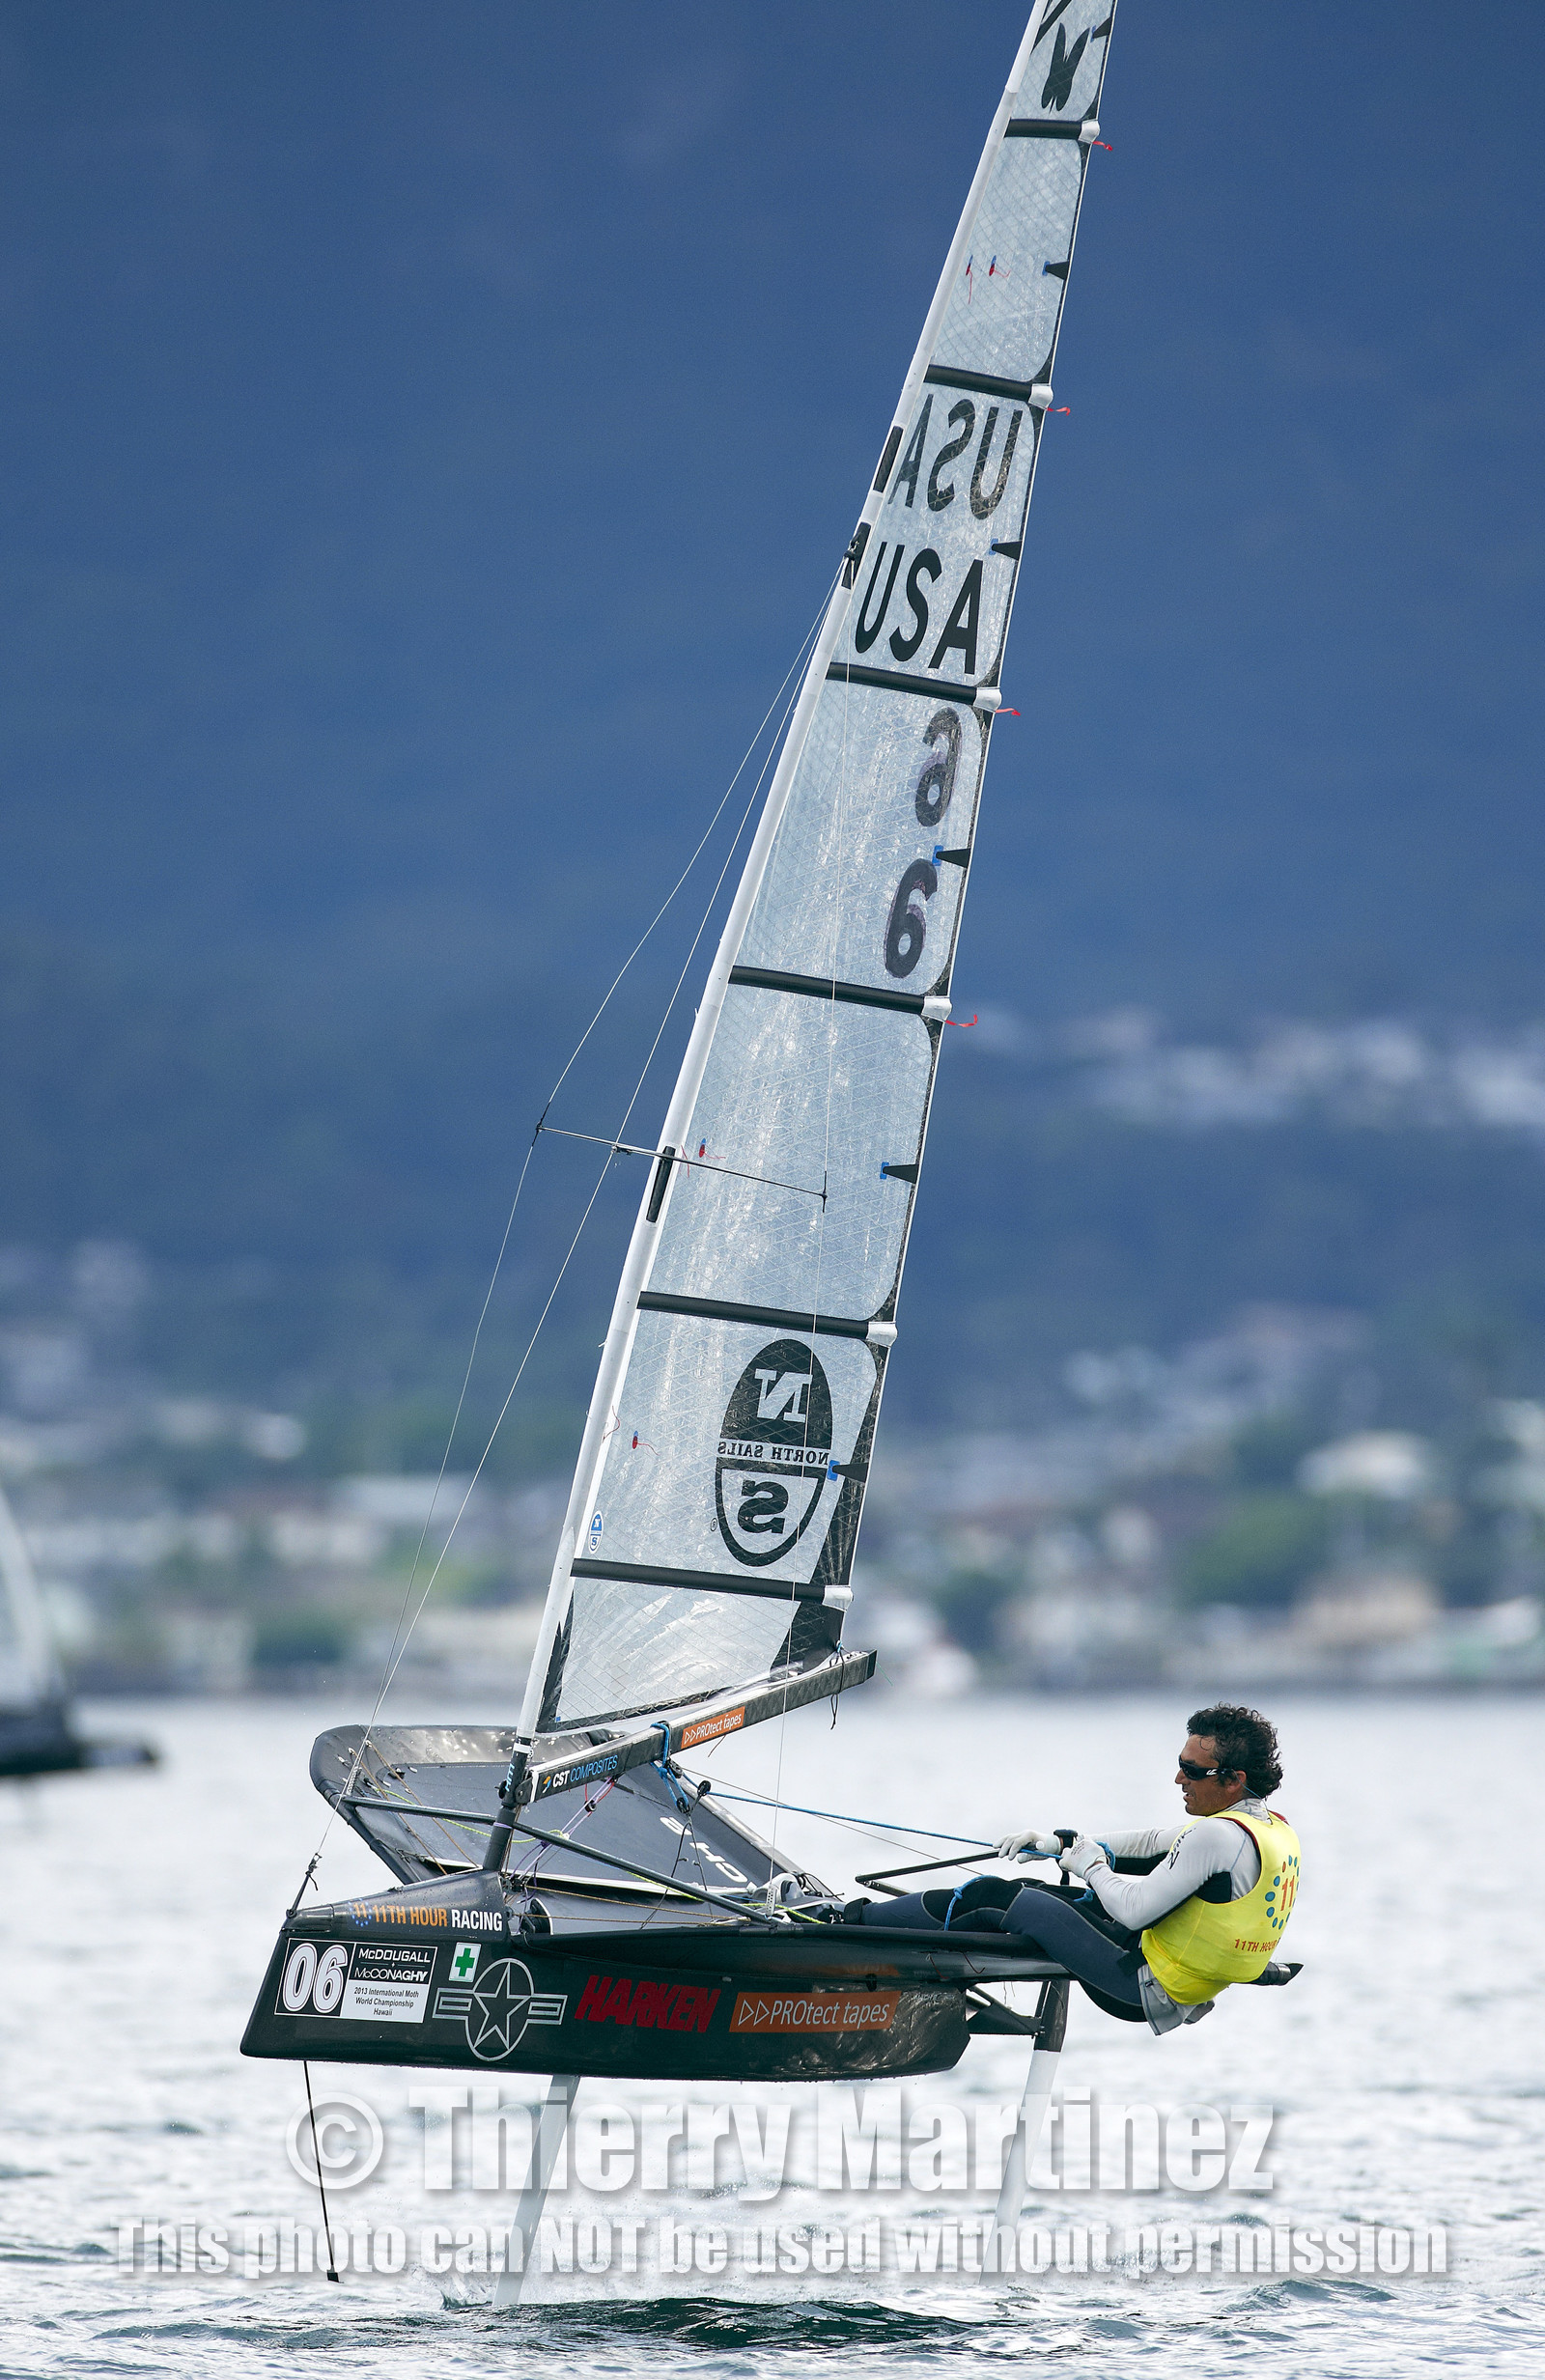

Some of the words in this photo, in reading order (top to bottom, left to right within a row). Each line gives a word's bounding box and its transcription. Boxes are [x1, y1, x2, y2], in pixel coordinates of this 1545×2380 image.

[855, 541, 984, 675] USA
[884, 857, 938, 979] 6
[695, 1721, 723, 1743] PROtect
[552, 1769, 570, 1788] CST
[570, 1754, 619, 1783] COMPOSITES
[372, 1904, 407, 1925] 11TH
[410, 1906, 448, 1928] HOUR
[451, 1909, 503, 1932] RACING
[358, 1947, 432, 1964] McDOUGALL
[1234, 1938, 1260, 1953] 11TH
[282, 1942, 350, 2015] 06
[353, 1967, 429, 1982] McCONAGHY
[353, 1986, 368, 1995] 2013
[368, 1988, 405, 1998] International
[405, 1990, 420, 1999] Moth
[355, 1997, 373, 2005] World
[373, 1998, 414, 2009] Championship
[574, 1974, 721, 2033] HARKEN
[769, 2000, 841, 2026] PROtect
[843, 2000, 890, 2030] tapes
